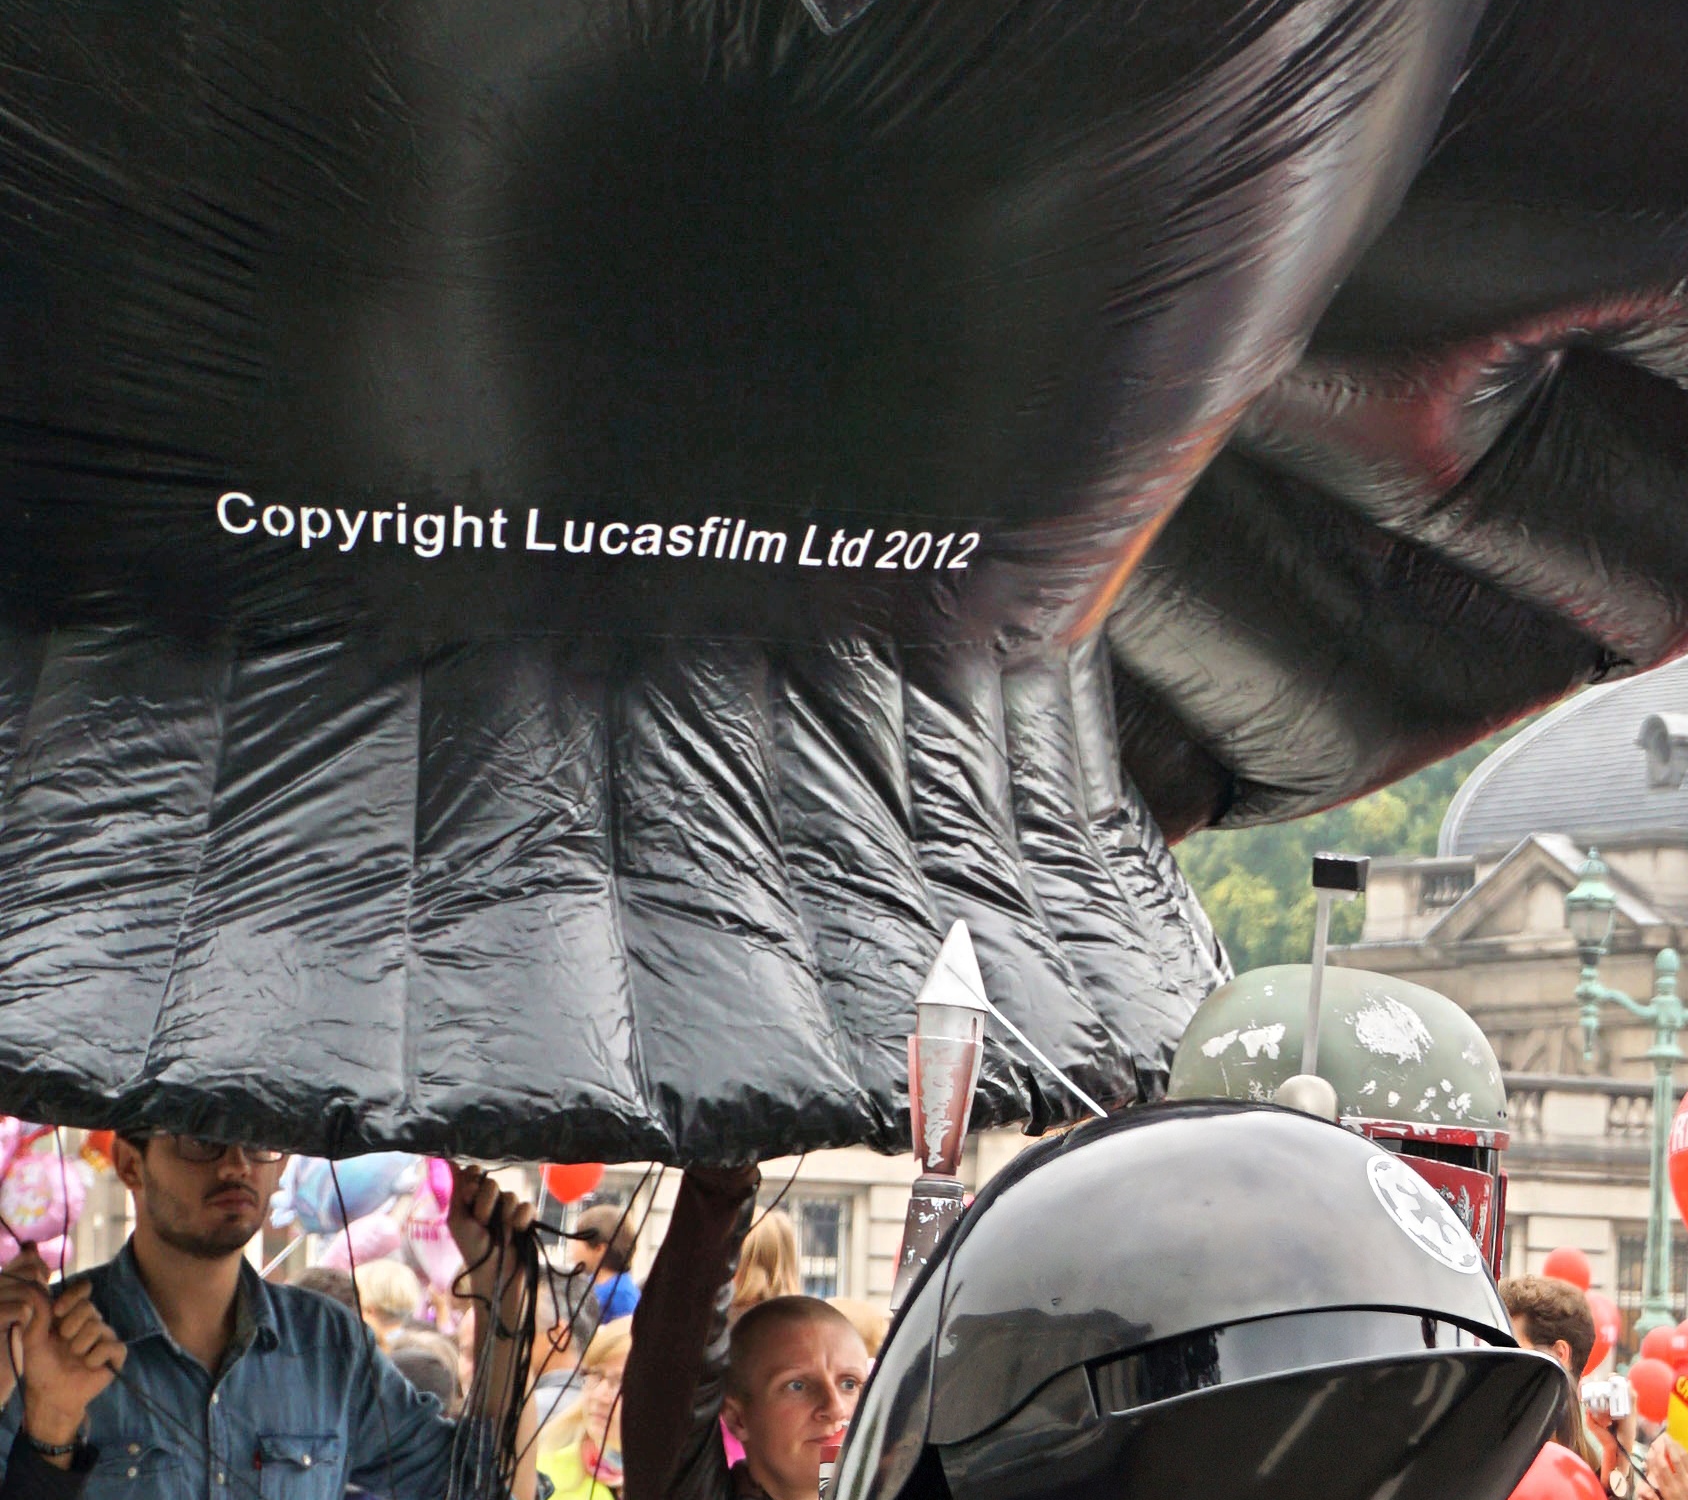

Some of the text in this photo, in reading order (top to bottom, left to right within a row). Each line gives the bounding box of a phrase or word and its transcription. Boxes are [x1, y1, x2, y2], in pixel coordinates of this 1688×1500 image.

[216, 492, 981, 570] Copyright Lucasfilm Ltd 2012
